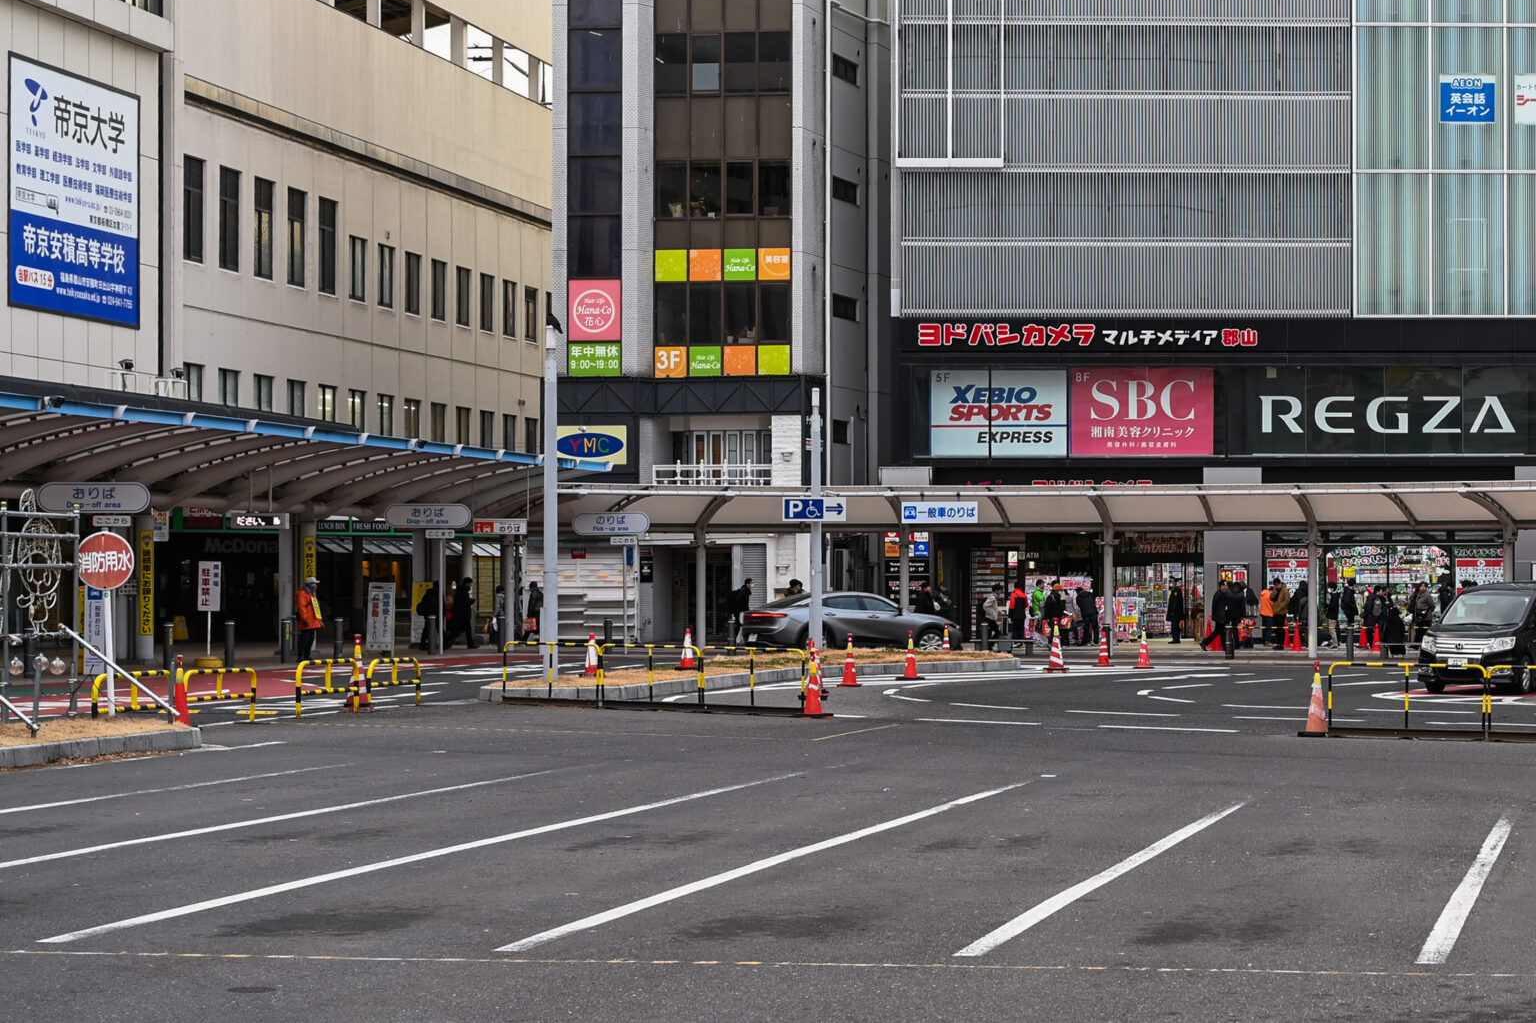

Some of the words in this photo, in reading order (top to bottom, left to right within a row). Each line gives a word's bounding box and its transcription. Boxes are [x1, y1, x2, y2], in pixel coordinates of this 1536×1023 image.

[1452, 79, 1482, 88] AEON
[1450, 92, 1486, 104] 英会話
[1445, 106, 1490, 116] イーオン
[53, 95, 126, 154] 帝京大学
[23, 223, 126, 275] 帝京安積高等学校
[725, 264, 755, 272] Hana-Co
[576, 305, 612, 315] Hana-Co
[584, 316, 605, 327] 花心
[918, 324, 1096, 347] ヨドバシカメラ
[570, 346, 619, 358] 年中無休
[656, 351, 681, 370] 3F
[690, 361, 721, 369] Hana-Co
[936, 372, 950, 383] 5F
[1076, 372, 1090, 382] 8F
[949, 384, 1037, 404] XEBIO
[1090, 379, 1195, 421] SBC
[948, 404, 1053, 422] SPORTS
[1259, 395, 1516, 434] REGZA
[977, 431, 1053, 444] EXPRESS
[1090, 425, 1195, 438] 湘南美容クリニック
[569, 437, 610, 454] YMC
[72, 487, 117, 500] おりば
[410, 507, 445, 517] おりば
[789, 500, 803, 518] P
[917, 506, 976, 518] 一般車のりば
[96, 518, 129, 526] ここから
[595, 515, 627, 525] のりば
[353, 522, 371, 531] FRESH
[372, 522, 389, 531] FOOD
[498, 522, 521, 533] のりば
[78, 550, 132, 574] 消防用水
[201, 568, 210, 607] 駐車禁止
